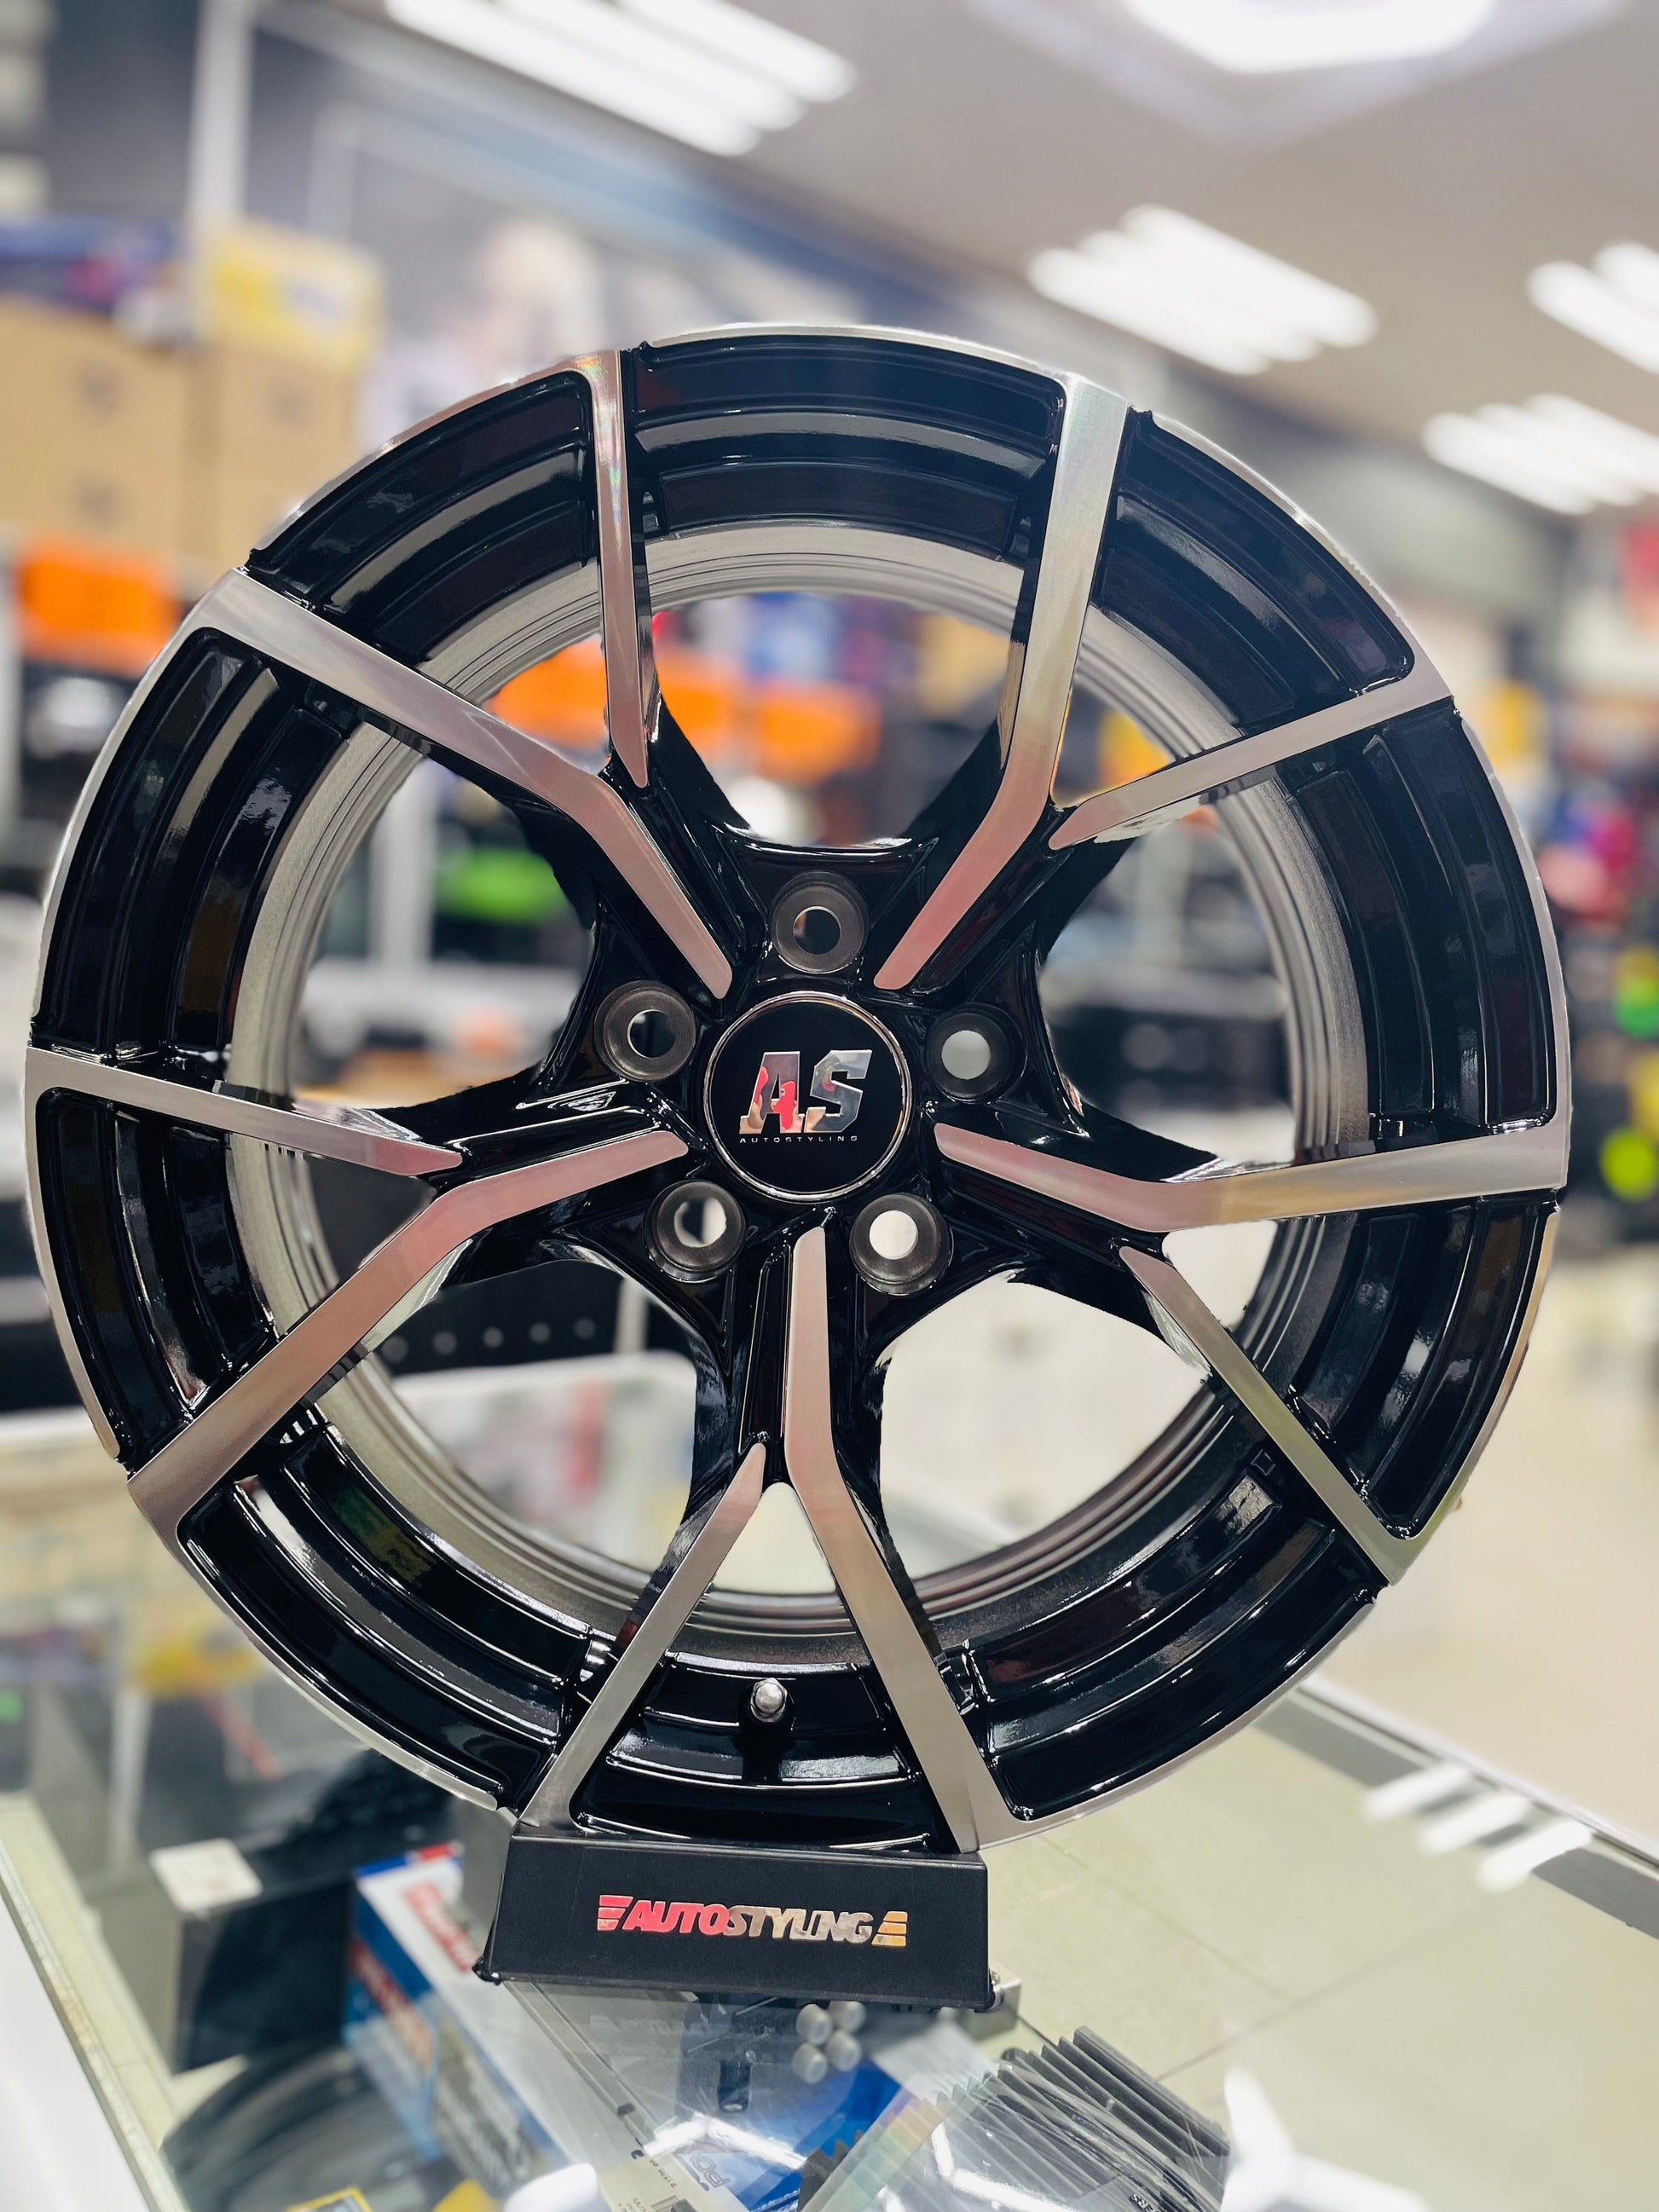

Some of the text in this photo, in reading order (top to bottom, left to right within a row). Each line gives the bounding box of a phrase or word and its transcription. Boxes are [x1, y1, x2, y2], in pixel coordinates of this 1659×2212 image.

[738, 1048, 873, 1135] AS
[739, 1135, 858, 1144] AUTOSTYLING
[622, 1899, 874, 1944] AUTOSTYLING
